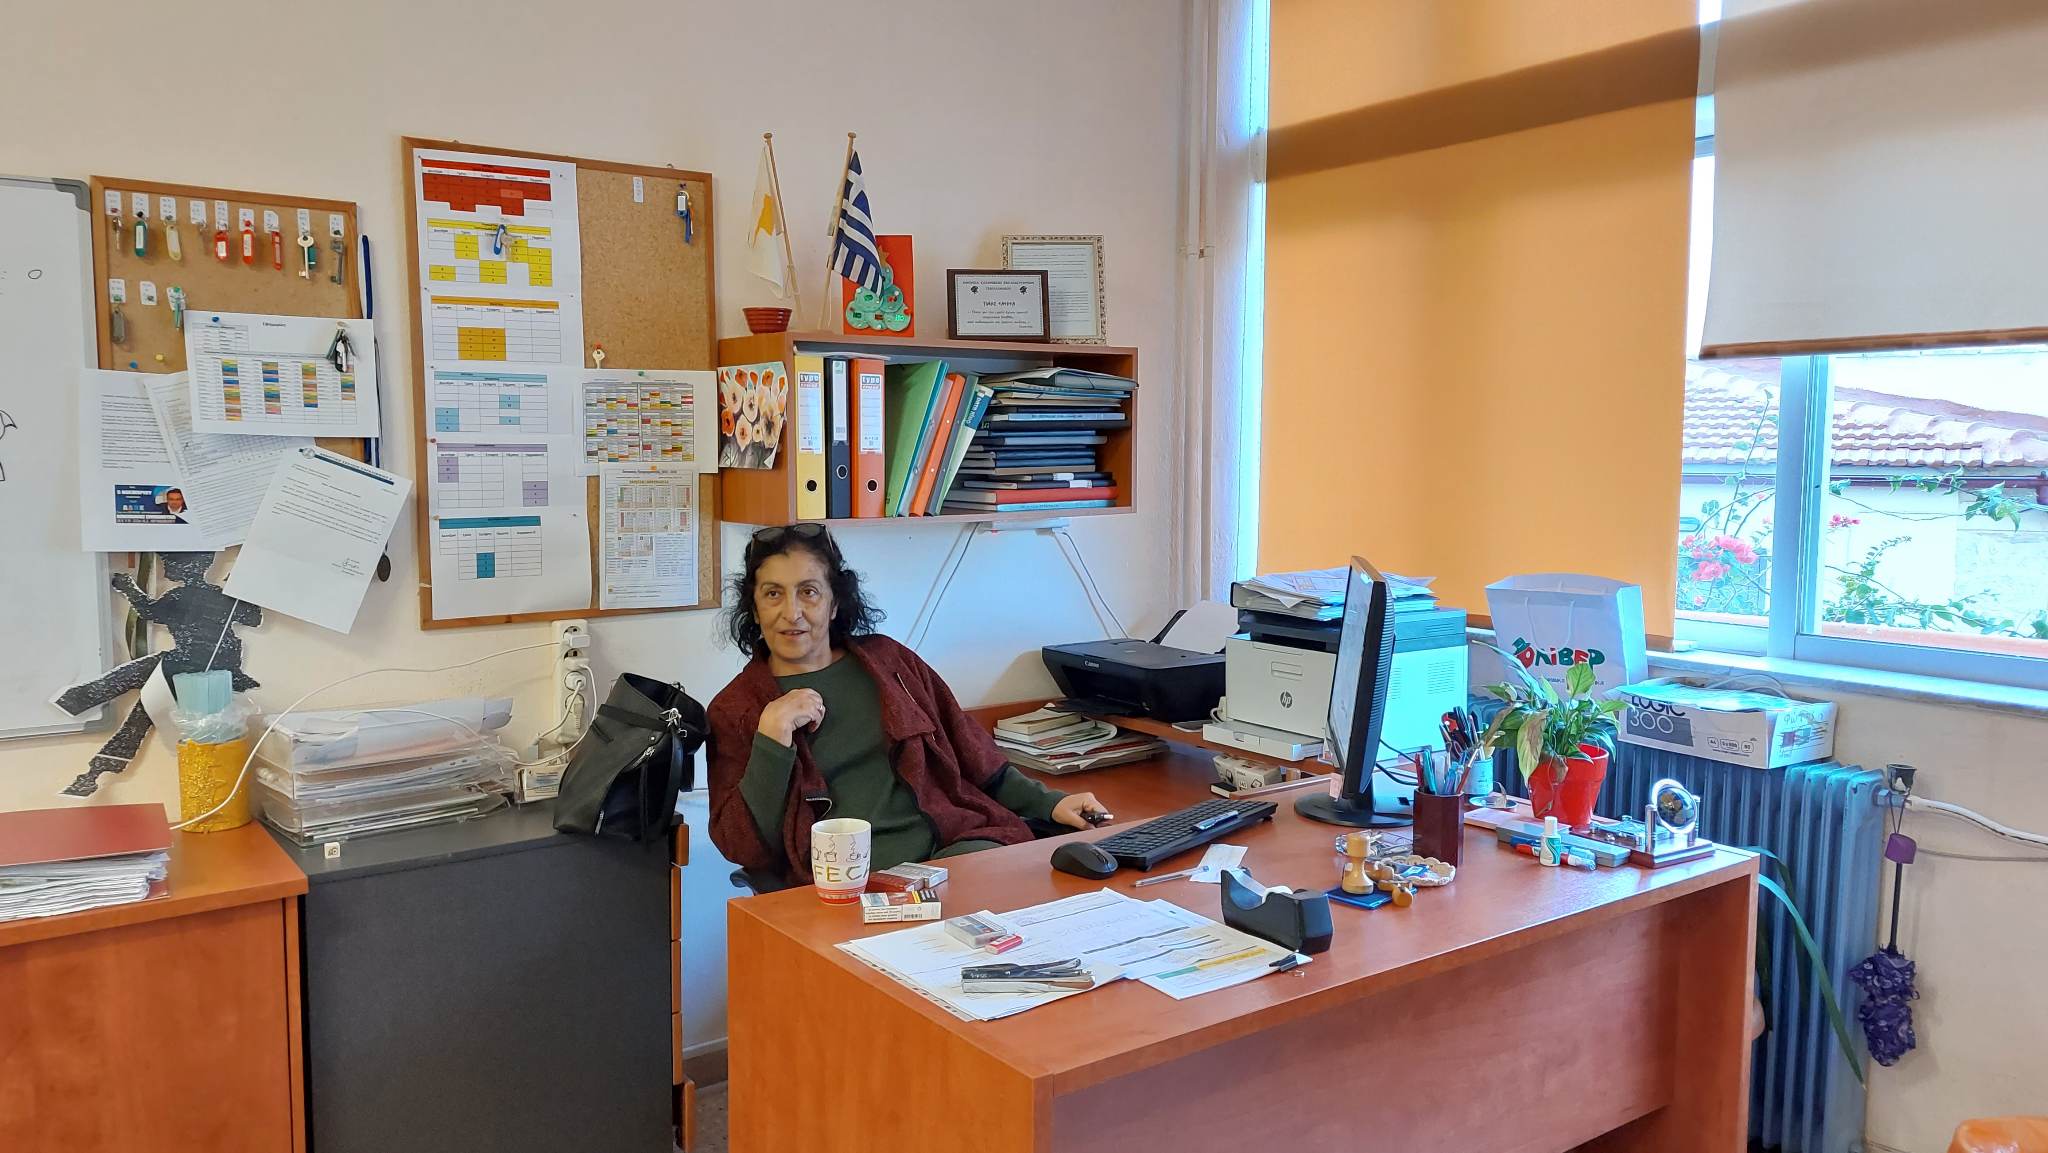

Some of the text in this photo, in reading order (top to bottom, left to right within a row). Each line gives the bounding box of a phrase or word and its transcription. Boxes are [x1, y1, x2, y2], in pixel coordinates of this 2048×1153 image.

[800, 374, 819, 382] typo
[862, 376, 880, 384] typo
[1280, 690, 1293, 708] hp
[1630, 708, 1674, 734] 300
